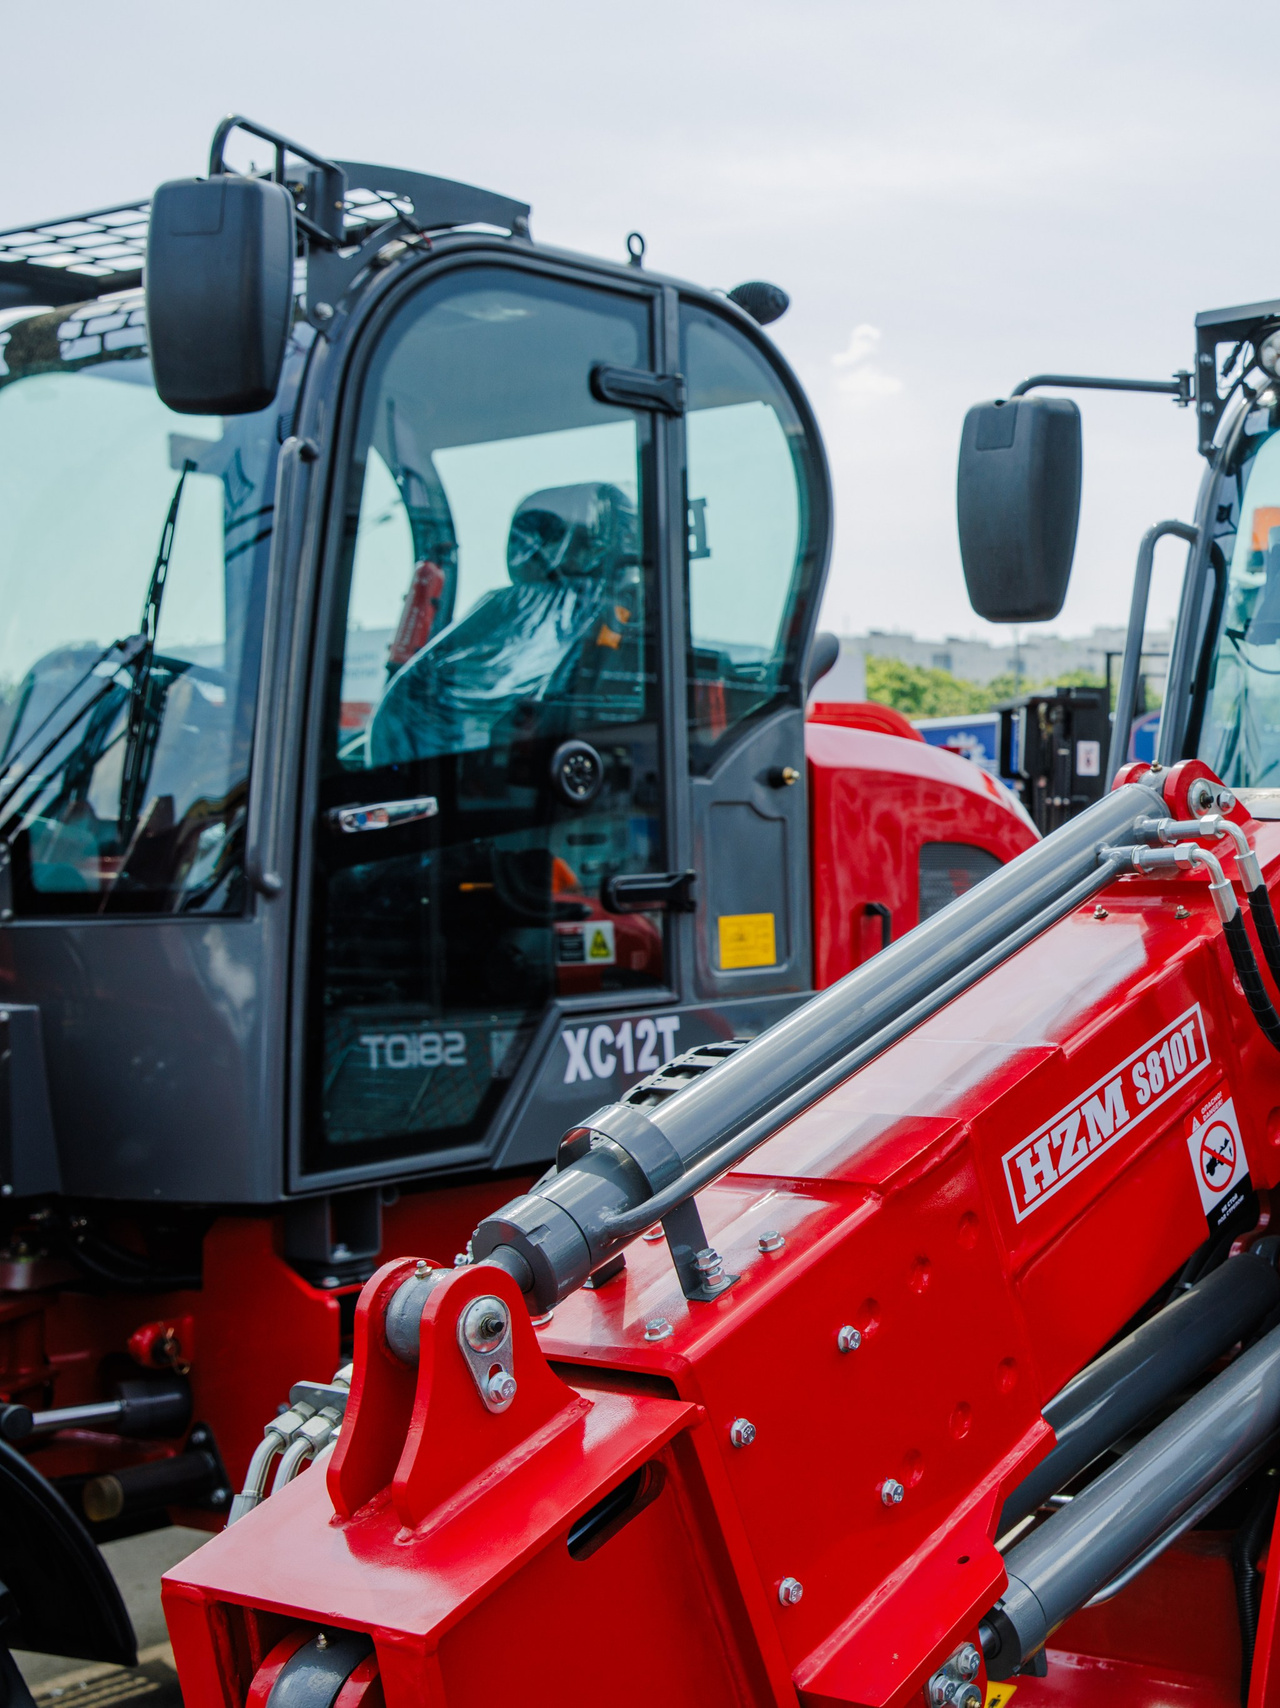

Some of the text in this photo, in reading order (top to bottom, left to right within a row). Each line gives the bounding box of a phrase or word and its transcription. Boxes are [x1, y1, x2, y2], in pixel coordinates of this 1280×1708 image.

[562, 1016, 680, 1083] XC12T
[1015, 1020, 1198, 1204] HZM S810T
